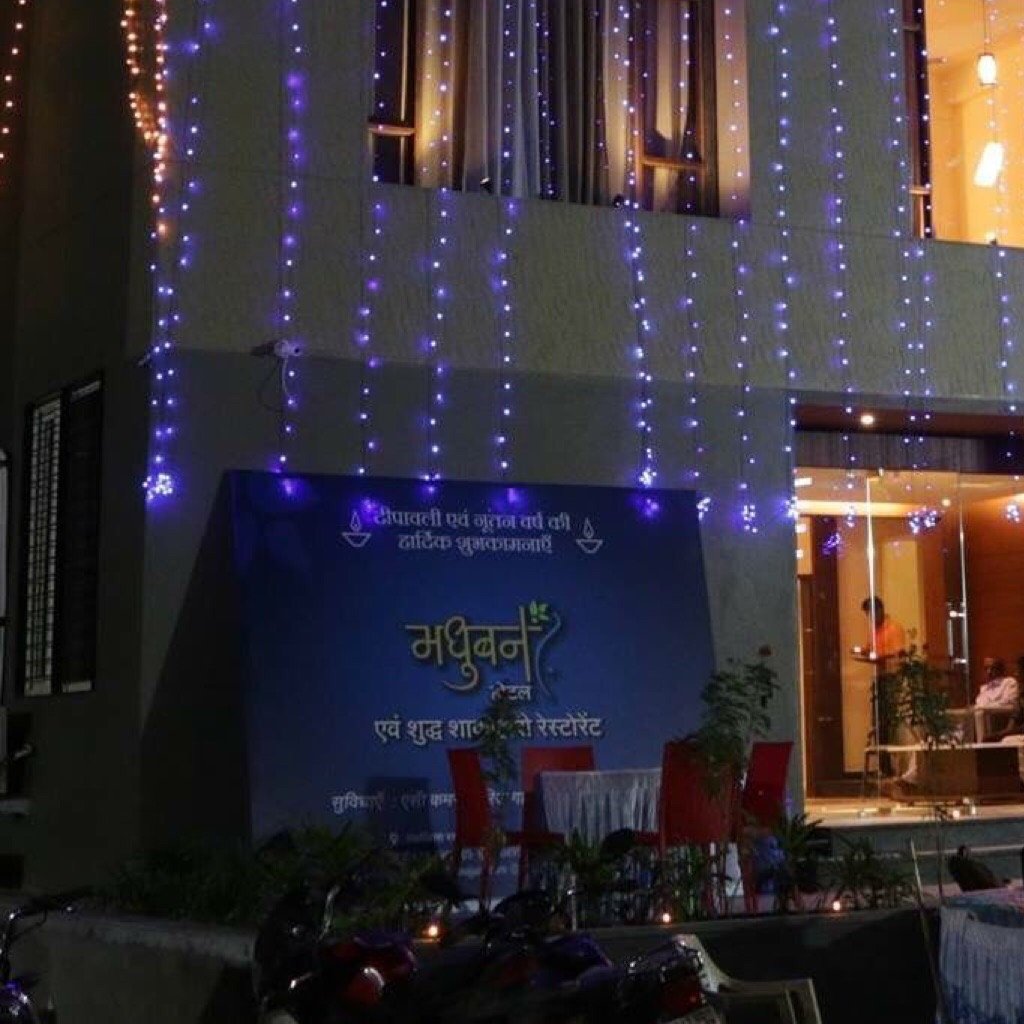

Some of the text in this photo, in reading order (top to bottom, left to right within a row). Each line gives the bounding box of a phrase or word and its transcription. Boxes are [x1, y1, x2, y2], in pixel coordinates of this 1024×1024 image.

[405, 605, 542, 690] मधुबन
[374, 714, 401, 744] एवं
[406, 720, 443, 746] शुद्ध
